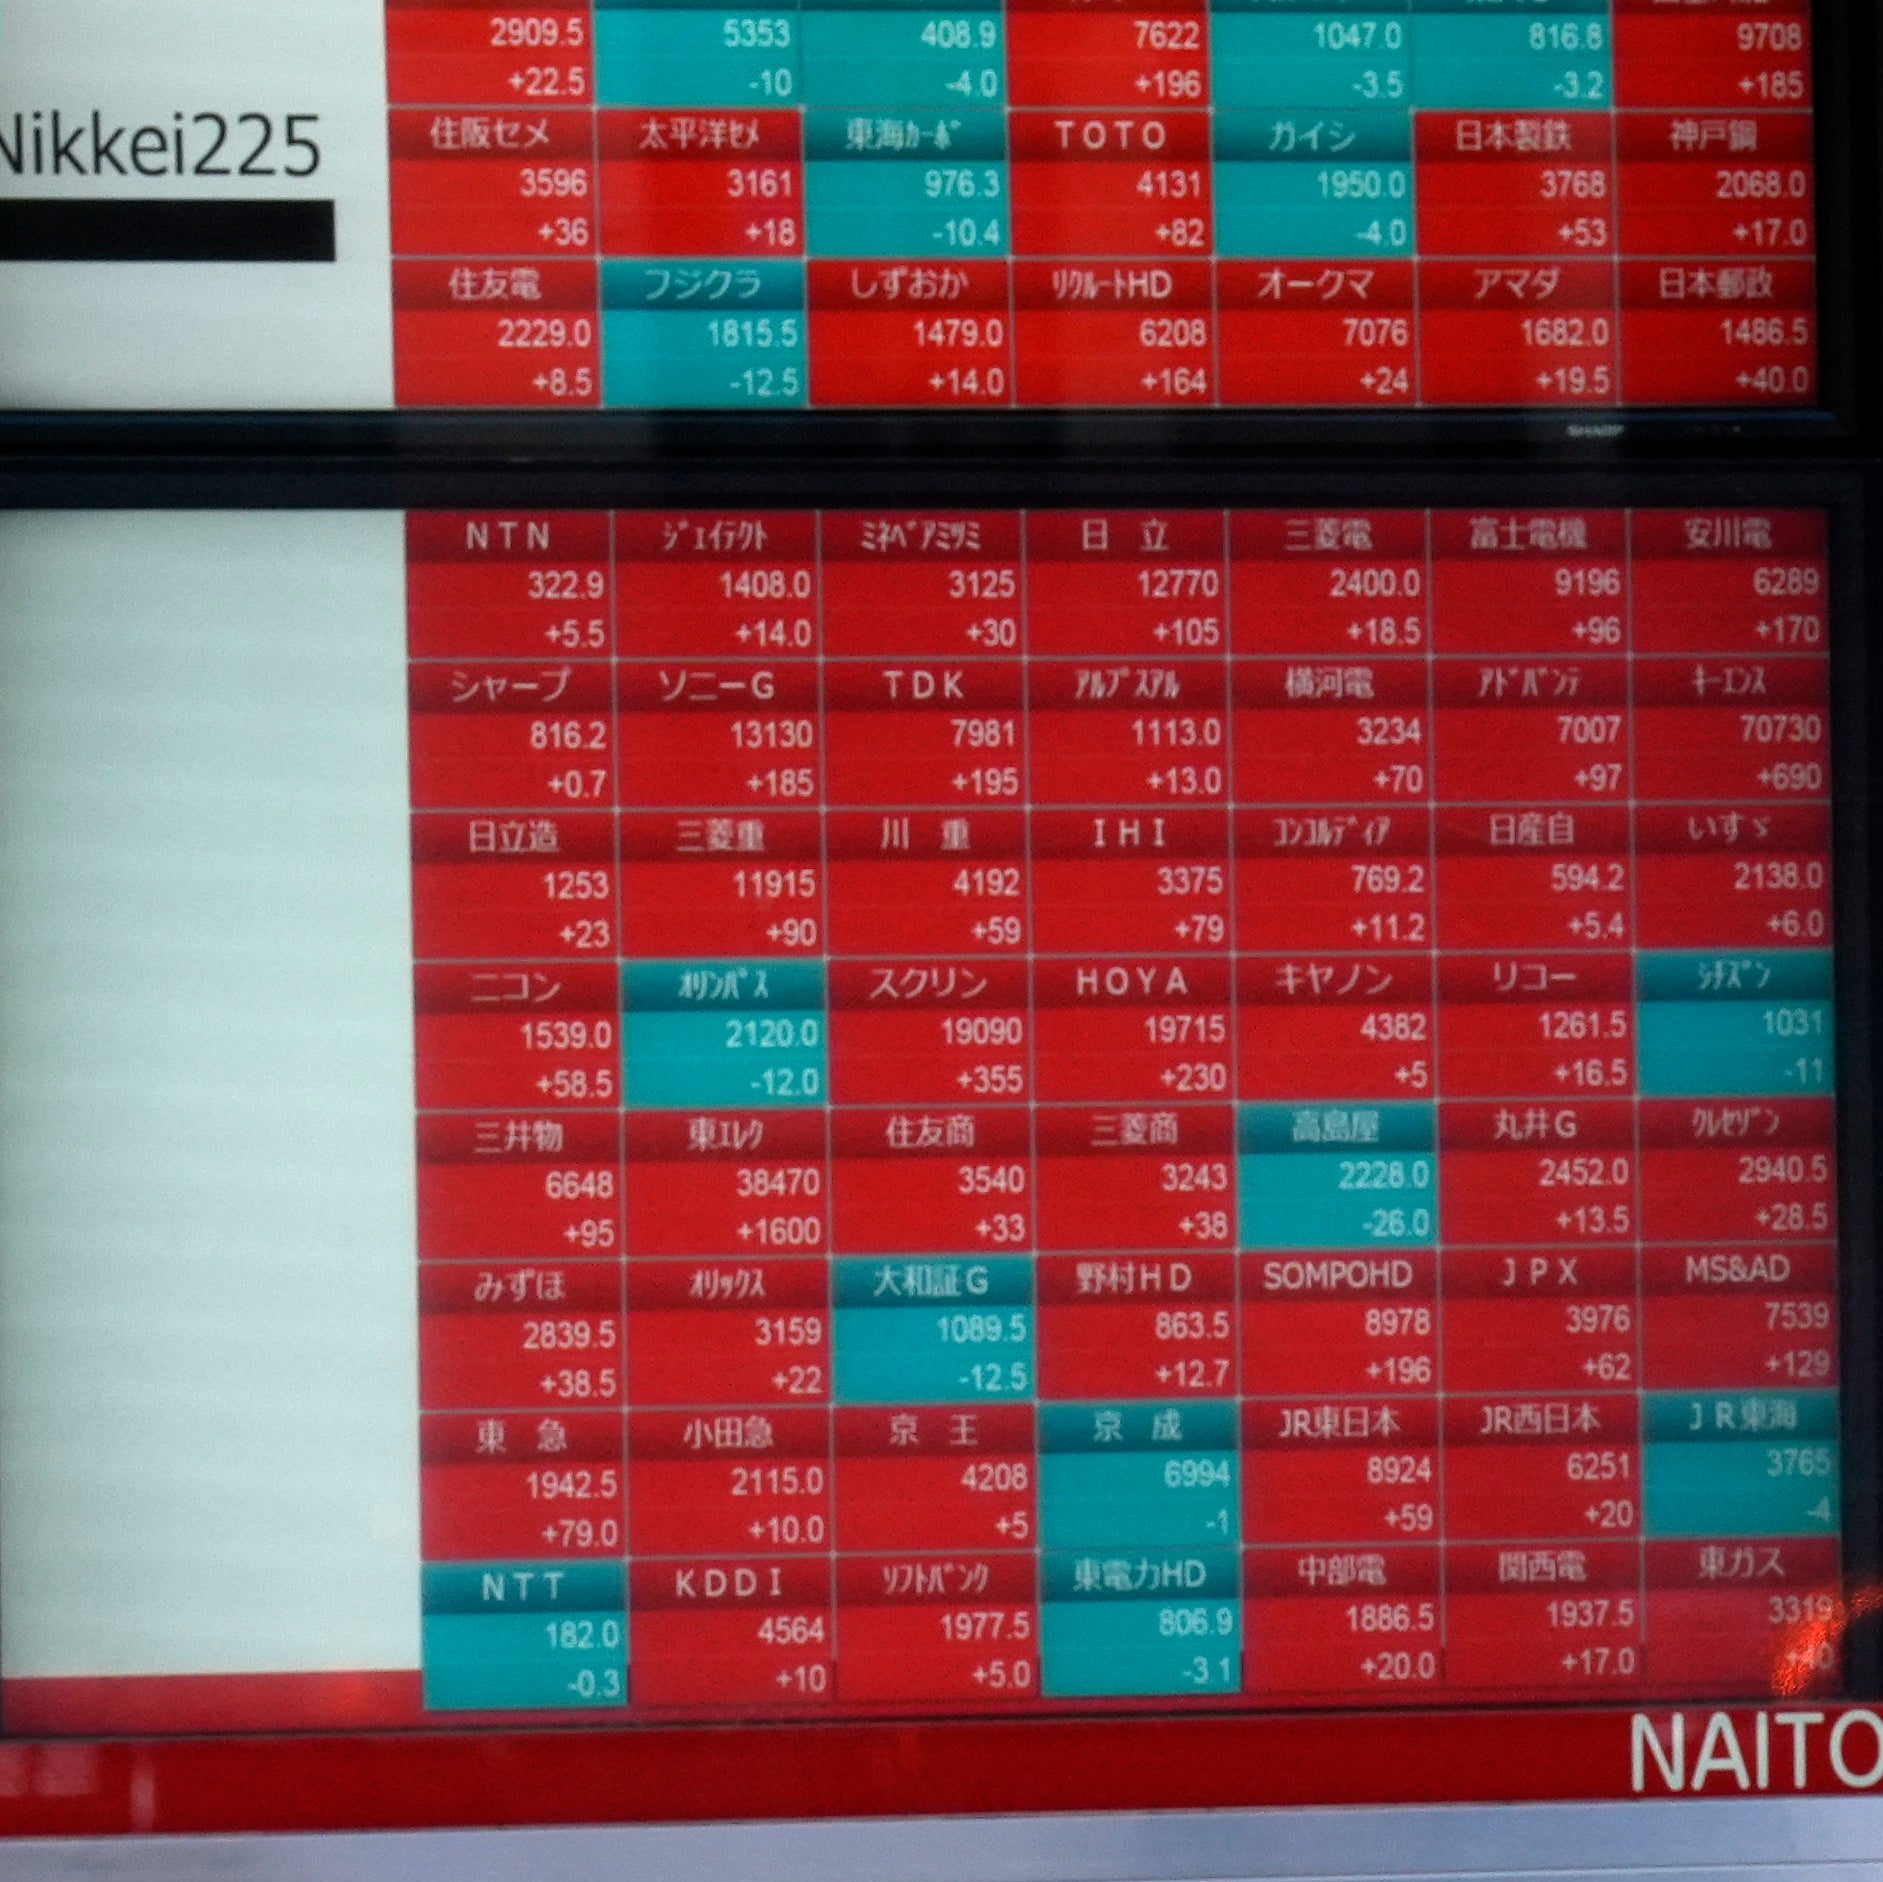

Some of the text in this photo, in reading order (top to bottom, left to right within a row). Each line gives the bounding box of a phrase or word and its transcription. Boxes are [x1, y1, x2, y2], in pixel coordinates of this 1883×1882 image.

[429, 115, 551, 150] 住阪セメ
[1053, 119, 1167, 151] TOTO
[1456, 118, 1573, 152] 日本製鉄
[519, 167, 590, 198] 3596
[1135, 169, 1202, 199] 4131
[1539, 167, 1609, 200] 3768
[536, 216, 591, 247] +36
[1153, 217, 1206, 248] +82
[1556, 216, 1610, 249] +53
[447, 267, 543, 301] 住友電
[645, 267, 763, 300] フジクラ
[1257, 267, 1376, 300] オークマ
[1475, 265, 1562, 300] アマダ
[496, 317, 593, 348] 2229.0
[708, 317, 799, 348] 1815.5
[1341, 316, 1411, 348] 7076
[1520, 316, 1612, 348] 1682.0
[531, 366, 594, 397] +8.5
[728, 366, 801, 398] -12.5
[1358, 365, 1411, 396] +24
[1534, 363, 1612, 396] +19.5
[465, 520, 551, 550] NTN
[1285, 517, 1374, 551] 三菱電
[527, 569, 606, 600] 322.9
[1328, 567, 1422, 598] 2400.0
[544, 618, 607, 649] +5.5
[1345, 615, 1423, 646] +18.5
[658, 670, 776, 701] ソニーG
[882, 669, 965, 700] TDK
[729, 718, 815, 750] 13130
[950, 718, 1016, 748] 7981
[745, 767, 816, 798] +185
[950, 766, 1021, 797] +195
[1092, 817, 1166, 848] IHI
[1488, 810, 1576, 847] 日産自
[542, 869, 611, 901] 1253
[1156, 864, 1225, 896] 3375
[1550, 862, 1626, 892] 594.2
[558, 918, 612, 949] +23
[1173, 913, 1227, 944] +79
[1566, 910, 1627, 941] +5.4
[868, 966, 989, 999] スクリン
[1075, 966, 1189, 996] HOYA
[1275, 962, 1394, 995] キヤノン
[940, 1015, 1025, 1046] 19090
[1143, 1013, 1227, 1044] 19715
[1359, 1011, 1428, 1042] 4382
[955, 1064, 1025, 1094] +355
[1159, 1061, 1229, 1093] +230
[1393, 1059, 1430, 1090] +5
[474, 1119, 565, 1153] 三井物
[1493, 1108, 1579, 1141] 丸井G
[544, 1169, 616, 1200] 6648
[1538, 1156, 1631, 1187] 2452.0
[562, 1218, 617, 1249] +95
[1554, 1204, 1632, 1235] +13.5
[1264, 1258, 1413, 1292] SOMPOHD
[1685, 1253, 1791, 1284] MS&AD
[473, 1268, 566, 1302] みずほ
[1363, 1306, 1433, 1337] 8978
[1763, 1300, 1832, 1331] 7539
[521, 1319, 618, 1350] 2839.5
[1365, 1354, 1434, 1385] +196
[1763, 1348, 1832, 1379] +129
[539, 1368, 618, 1399] +38.5
[682, 1414, 775, 1450] 小田急
[1278, 1404, 1399, 1440] JR東日本
[729, 1465, 826, 1497] 2115.0
[1365, 1454, 1434, 1485] 8924
[747, 1514, 826, 1545] +10.0
[1382, 1502, 1436, 1532] +59
[674, 1566, 783, 1598] KDDI
[1296, 1553, 1388, 1587] 中部電
[756, 1615, 827, 1645] 4564
[1345, 1602, 1436, 1633] 1886.5
[774, 1662, 828, 1694] +10
[1359, 1650, 1437, 1681] +20.0
